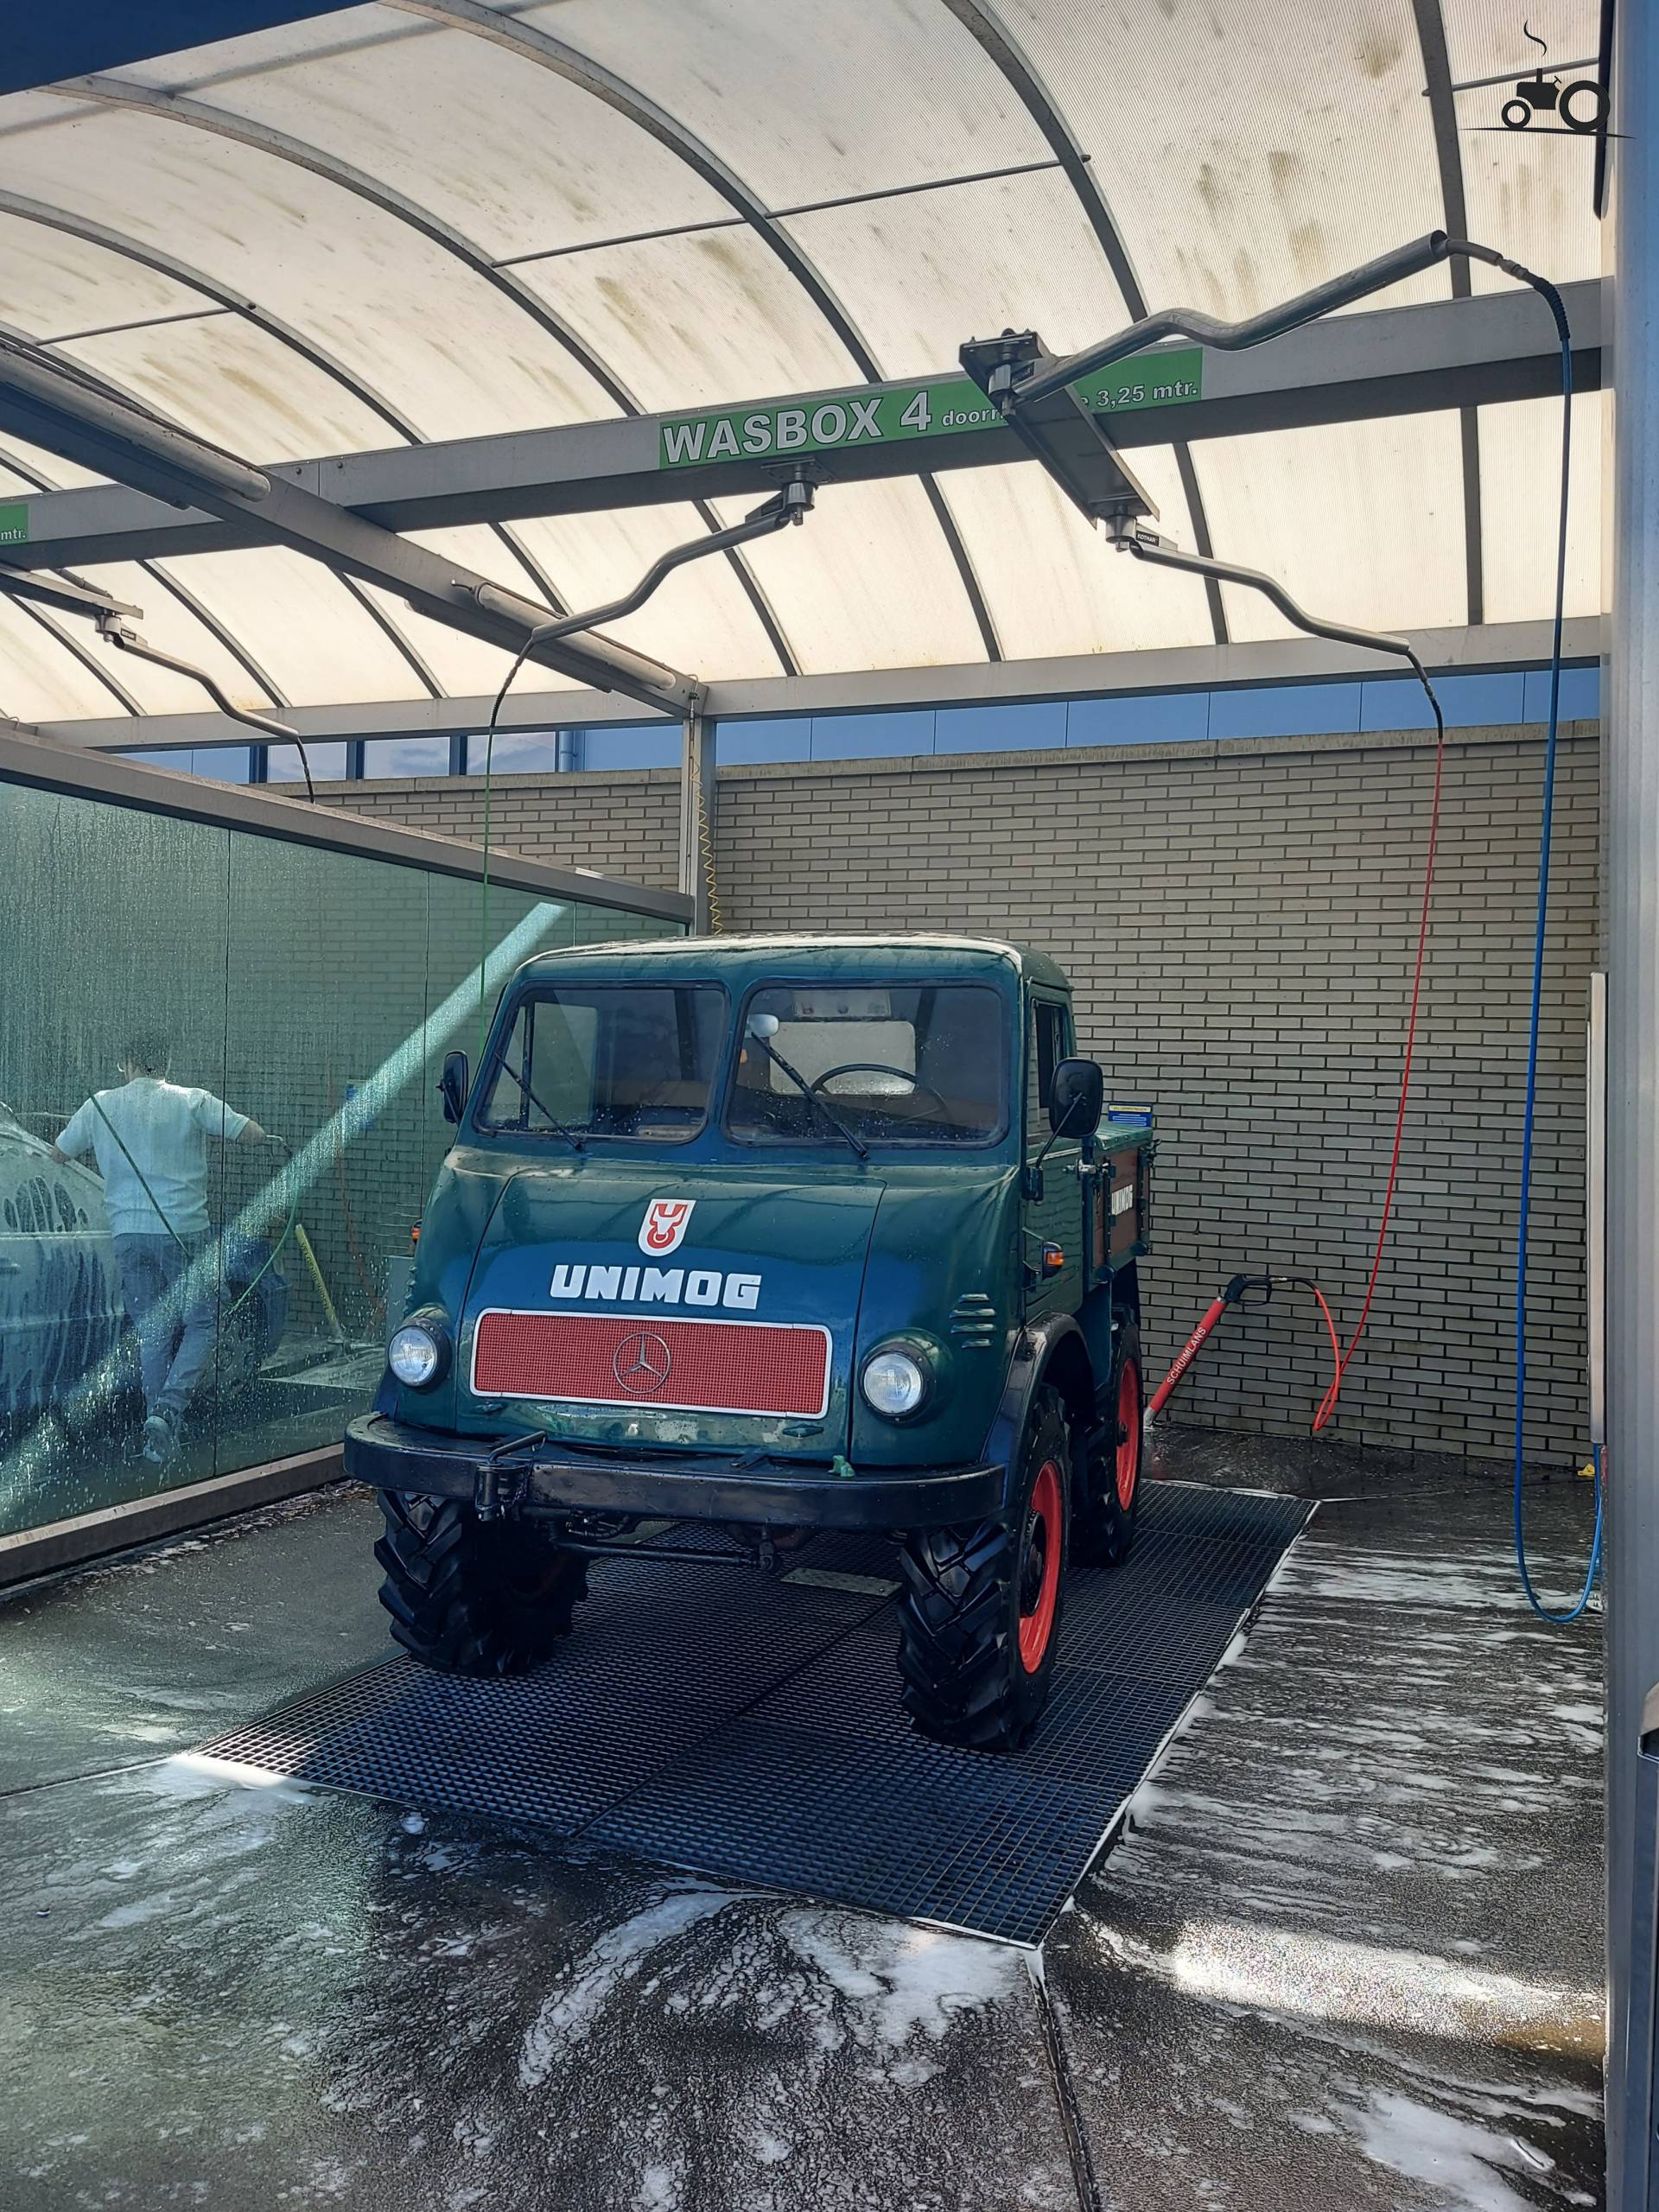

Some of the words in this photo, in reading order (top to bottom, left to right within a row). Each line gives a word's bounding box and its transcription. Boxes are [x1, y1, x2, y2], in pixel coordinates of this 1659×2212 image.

[662, 397, 884, 464] WASBOX
[899, 391, 932, 431] 4
[1096, 385, 1145, 409] 3,25
[1153, 380, 1198, 400] mtr.
[1, 528, 26, 541] mtr.
[550, 1264, 762, 1310] UNIMOG
[1166, 1326, 1206, 1384] SCHUIMLANS
